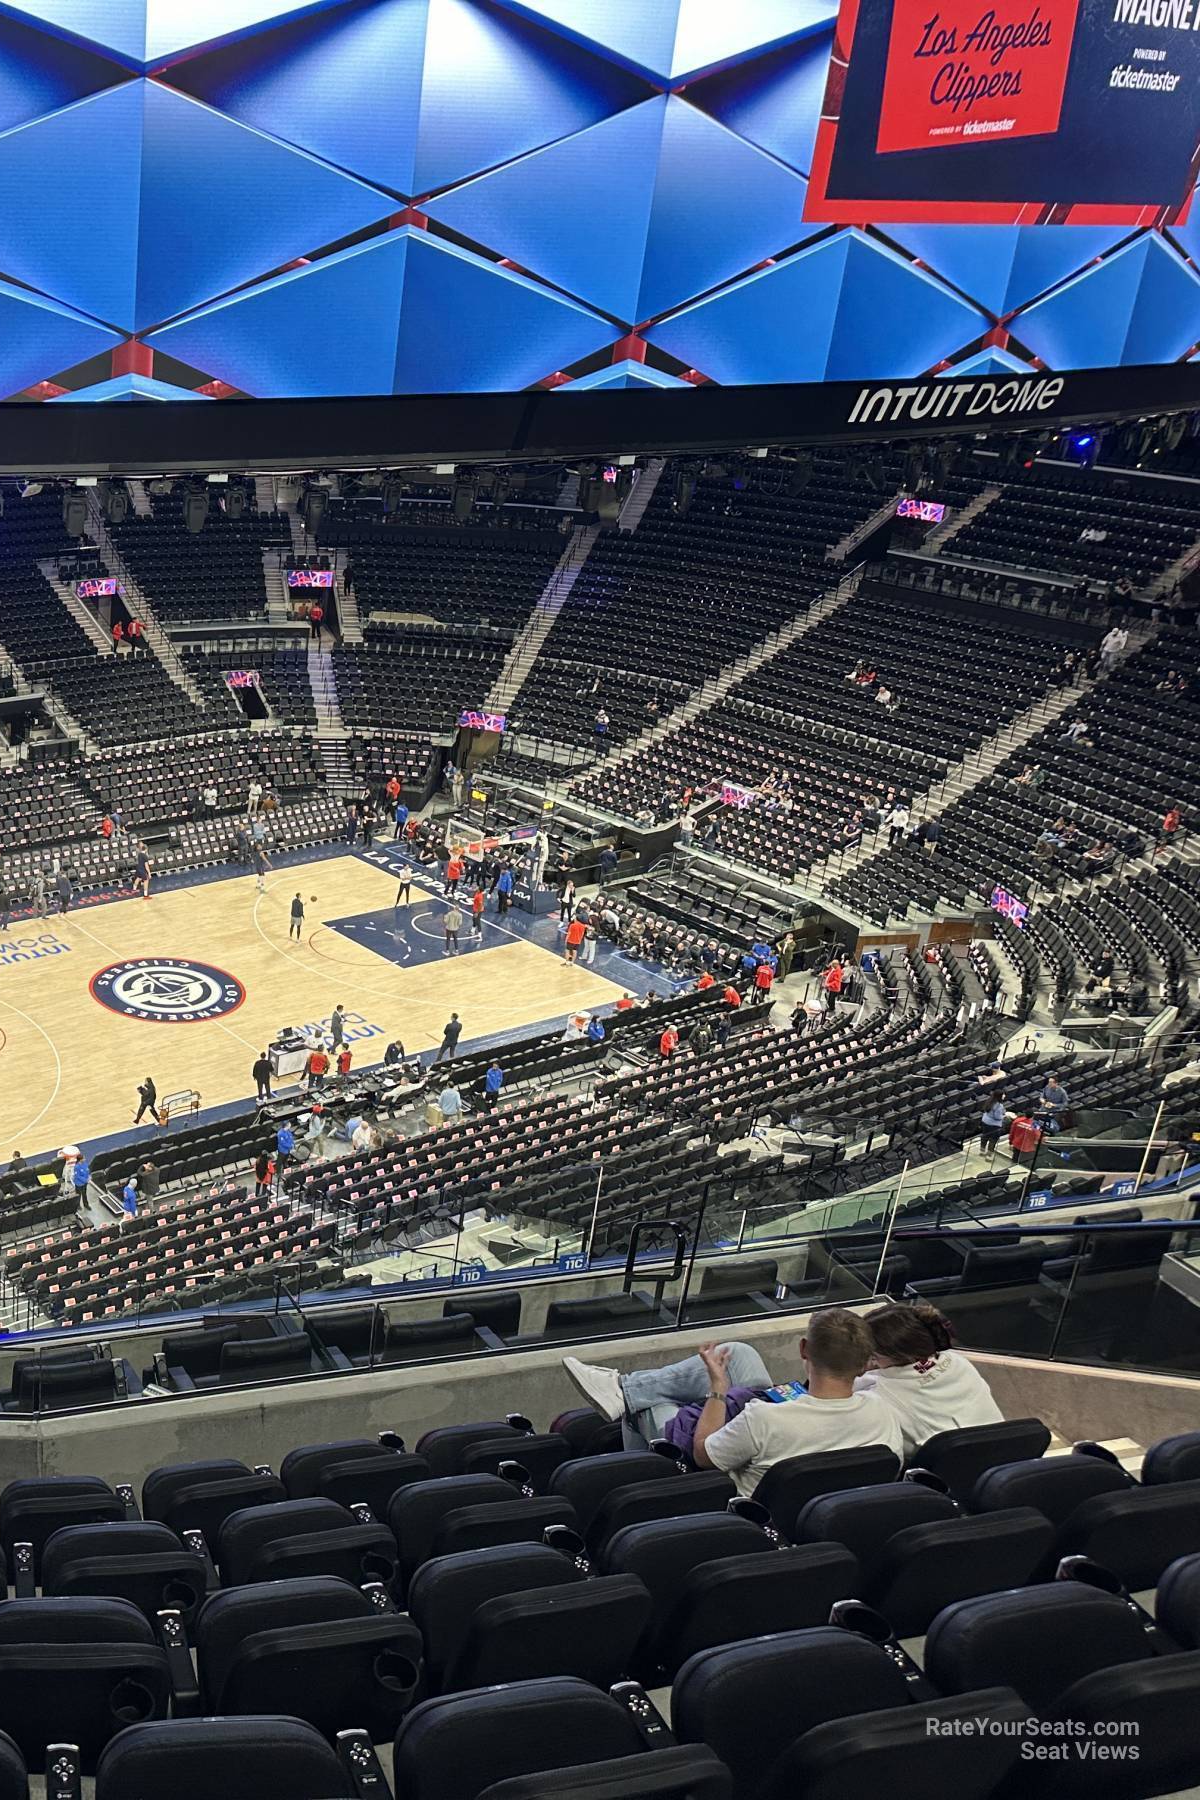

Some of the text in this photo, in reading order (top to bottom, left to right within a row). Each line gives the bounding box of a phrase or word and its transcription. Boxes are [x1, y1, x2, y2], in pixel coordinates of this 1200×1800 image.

[1113, 0, 1200, 31] MAGNE
[913, 6, 1052, 66] Los Angeles
[1133, 48, 1159, 61] POWERED
[930, 61, 1022, 113] Clippers
[1109, 64, 1181, 92] ticketmaster
[963, 118, 1016, 136] ticketmaster
[847, 384, 976, 423] INTUIT
[98, 959, 190, 986] CLIPPERS
[123, 984, 237, 1021] LOS ANGELES
[461, 1271, 481, 1283] 11D
[565, 1259, 583, 1270] 11C
